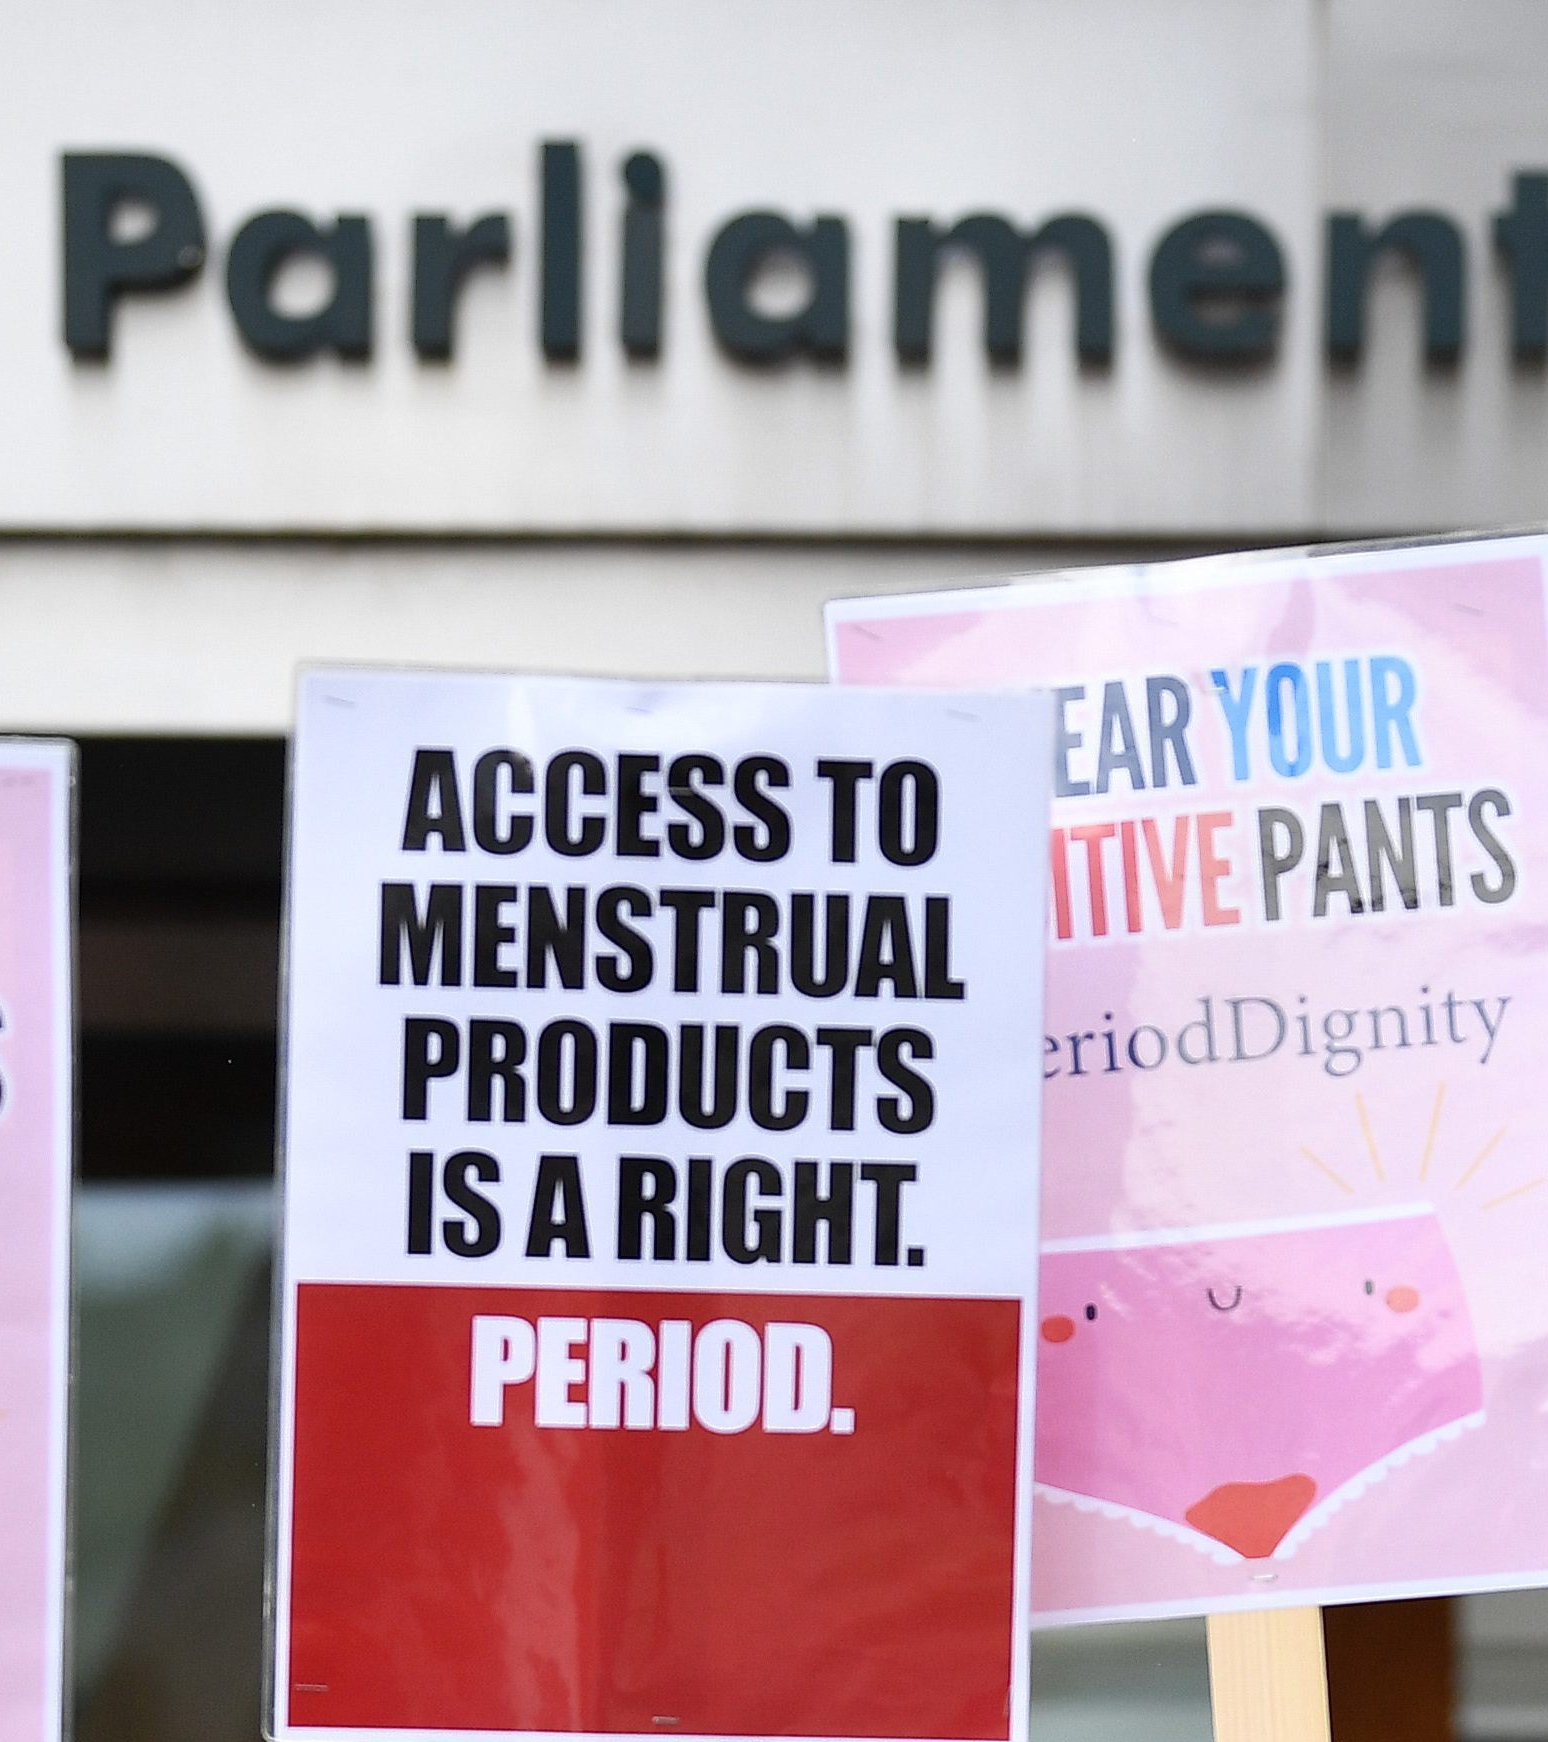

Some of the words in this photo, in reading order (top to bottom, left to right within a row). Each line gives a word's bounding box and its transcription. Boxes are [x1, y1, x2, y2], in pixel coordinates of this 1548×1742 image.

[1053, 674, 1196, 798] EAR
[1211, 654, 1422, 781] YOUR
[400, 748, 792, 864] ACCESS
[817, 756, 940, 866] TO
[1049, 811, 1240, 940] ITIVE
[1257, 788, 1516, 922] PANTS
[378, 882, 966, 1000] MENSTRUAL
[399, 1017, 936, 1135] PRODUCTS
[1043, 984, 1512, 1078] eriodDignity
[405, 1150, 503, 1258] IS
[525, 1155, 591, 1259] A
[617, 1157, 926, 1268] RIGHT.
[470, 1315, 856, 1435] PERIOD.
